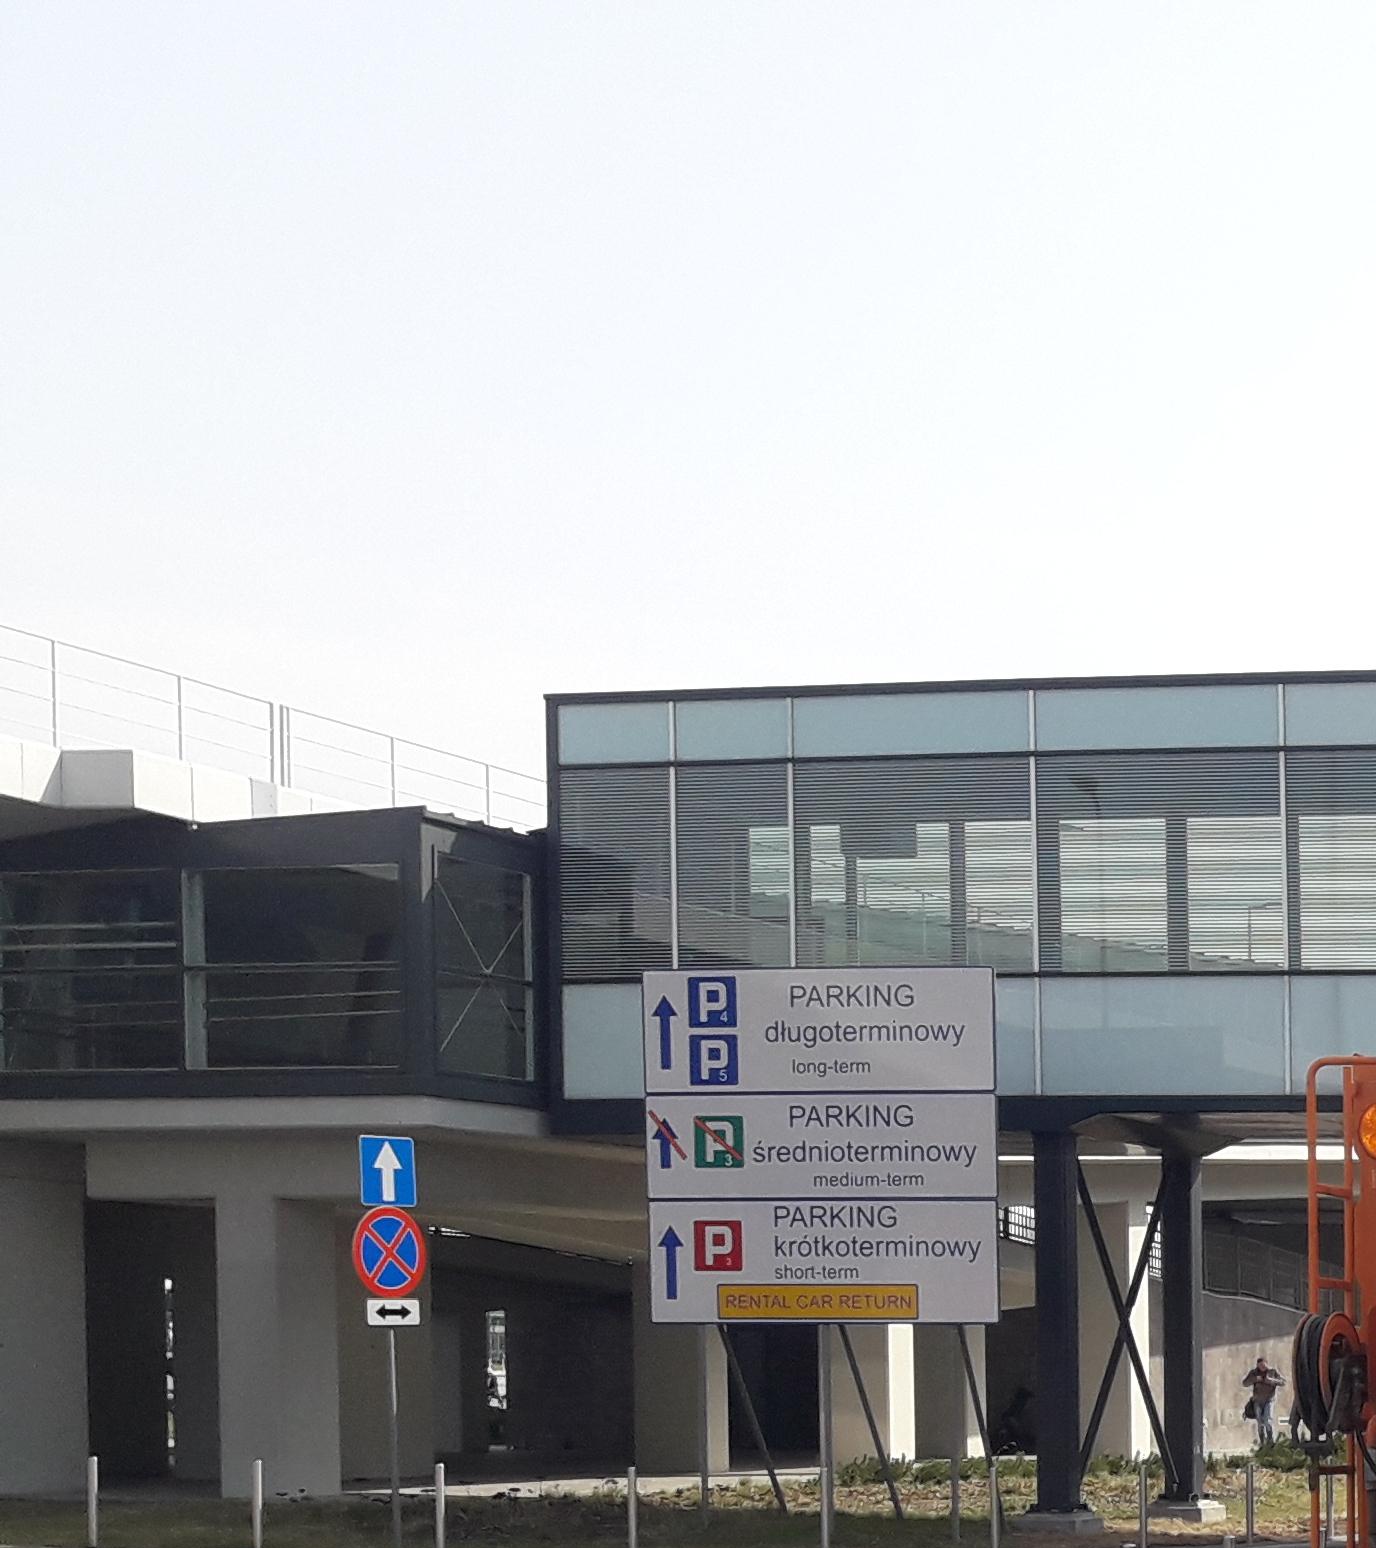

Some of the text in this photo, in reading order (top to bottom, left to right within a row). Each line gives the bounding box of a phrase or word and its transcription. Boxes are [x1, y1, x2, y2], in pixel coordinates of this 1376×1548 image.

[789, 985, 915, 1008] PARKING
[764, 1020, 966, 1047] długoterminowy
[791, 1058, 871, 1074] long-term
[788, 1105, 914, 1128] PARKING
[752, 1139, 977, 1167] średnioterminowy
[813, 1171, 925, 1188] medium-term
[773, 1205, 898, 1228] PARKING
[774, 1233, 982, 1263] krótkoterminowy
[774, 1265, 859, 1280] short-term
[725, 1294, 912, 1310] RENTAL CAR RETURN
